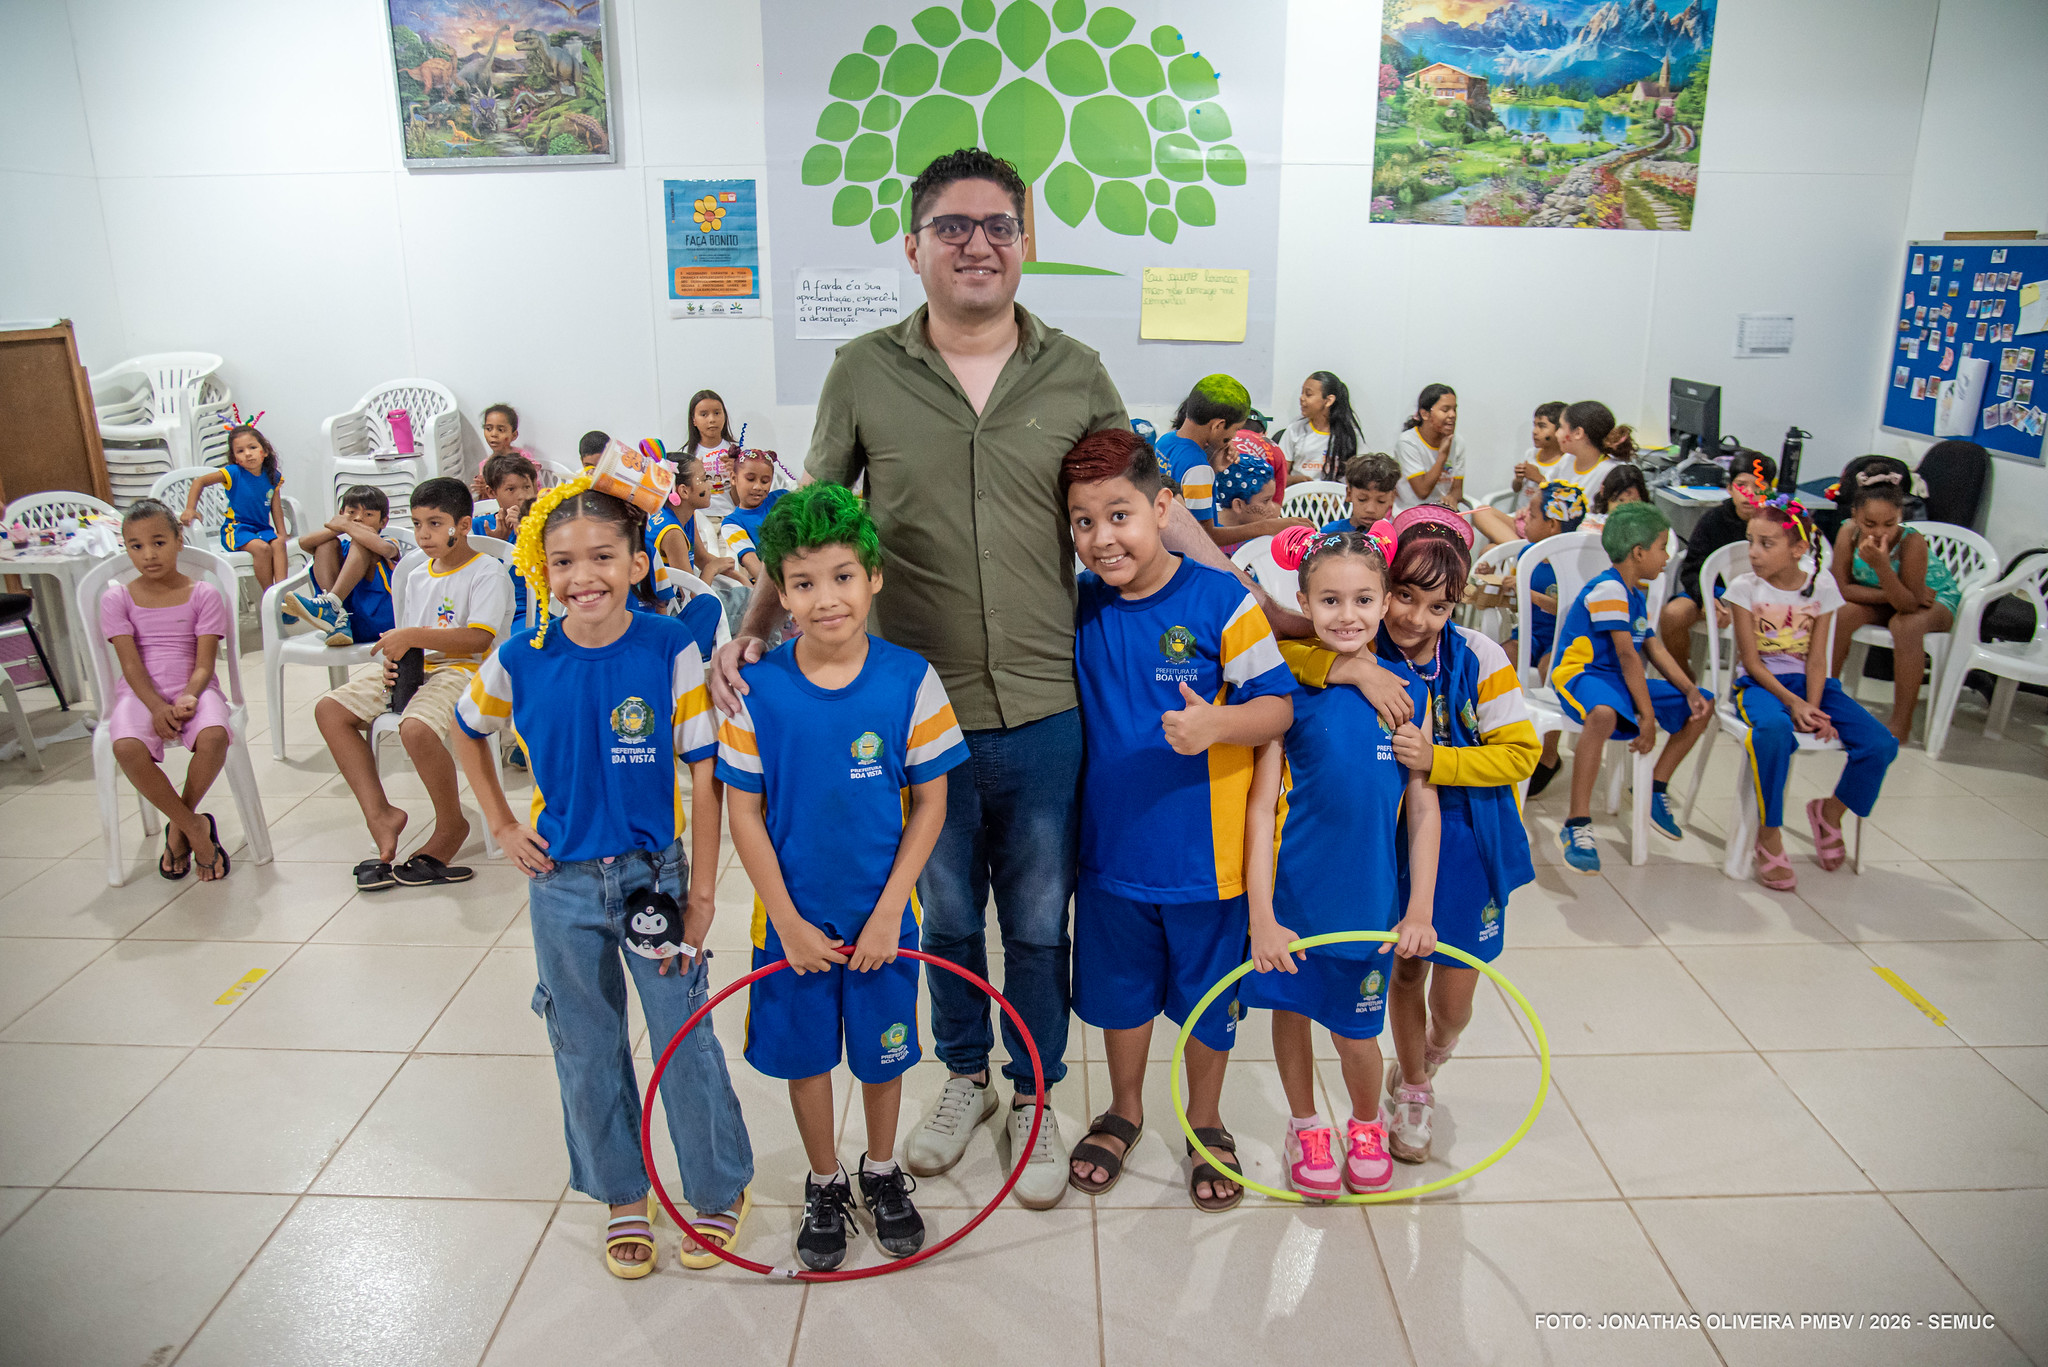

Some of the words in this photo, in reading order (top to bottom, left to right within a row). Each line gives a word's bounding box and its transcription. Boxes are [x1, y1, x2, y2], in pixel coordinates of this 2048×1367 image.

[685, 234, 707, 248] FAÇA
[709, 234, 739, 247] BONITO
[802, 280, 811, 291] A
[814, 278, 843, 299] farda
[815, 305, 853, 316] primeiro
[879, 306, 898, 317] para
[1155, 667, 1190, 675] PREFEITURA
[1155, 673, 1174, 682] BOA
[1174, 674, 1198, 682] VISTA
[629, 754, 656, 764] VISTA
[1377, 752, 1392, 761] BOA
[866, 769, 883, 778] VISTA
